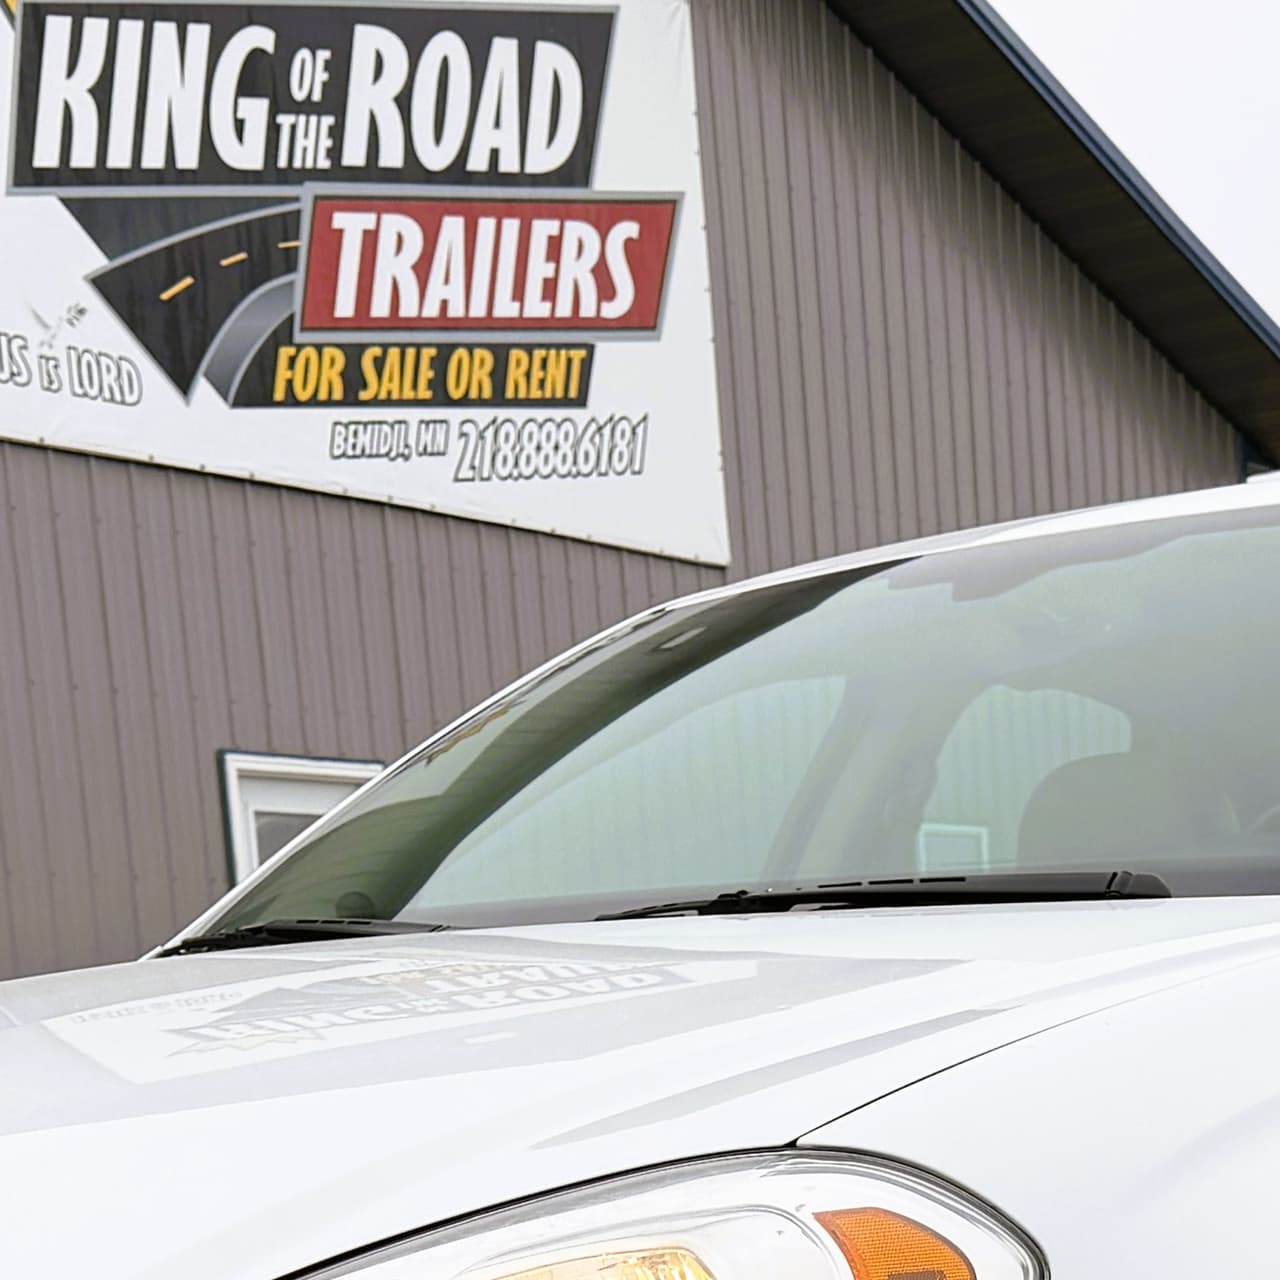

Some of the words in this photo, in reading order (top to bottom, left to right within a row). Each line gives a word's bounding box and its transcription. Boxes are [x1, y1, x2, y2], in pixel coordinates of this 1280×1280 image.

[33, 14, 276, 171] KING
[289, 48, 331, 103] OF
[341, 23, 584, 174] ROAD
[275, 113, 336, 170] THE
[331, 210, 640, 321] TRAILERS
[66, 346, 144, 406] LORD
[272, 345, 345, 402] FOR
[358, 347, 436, 402] SALE
[445, 347, 493, 400] OR
[504, 347, 588, 400] RENT
[330, 420, 411, 461] BEMIDJI,
[415, 419, 451, 457] MN
[453, 413, 649, 483] 218.888.6181
